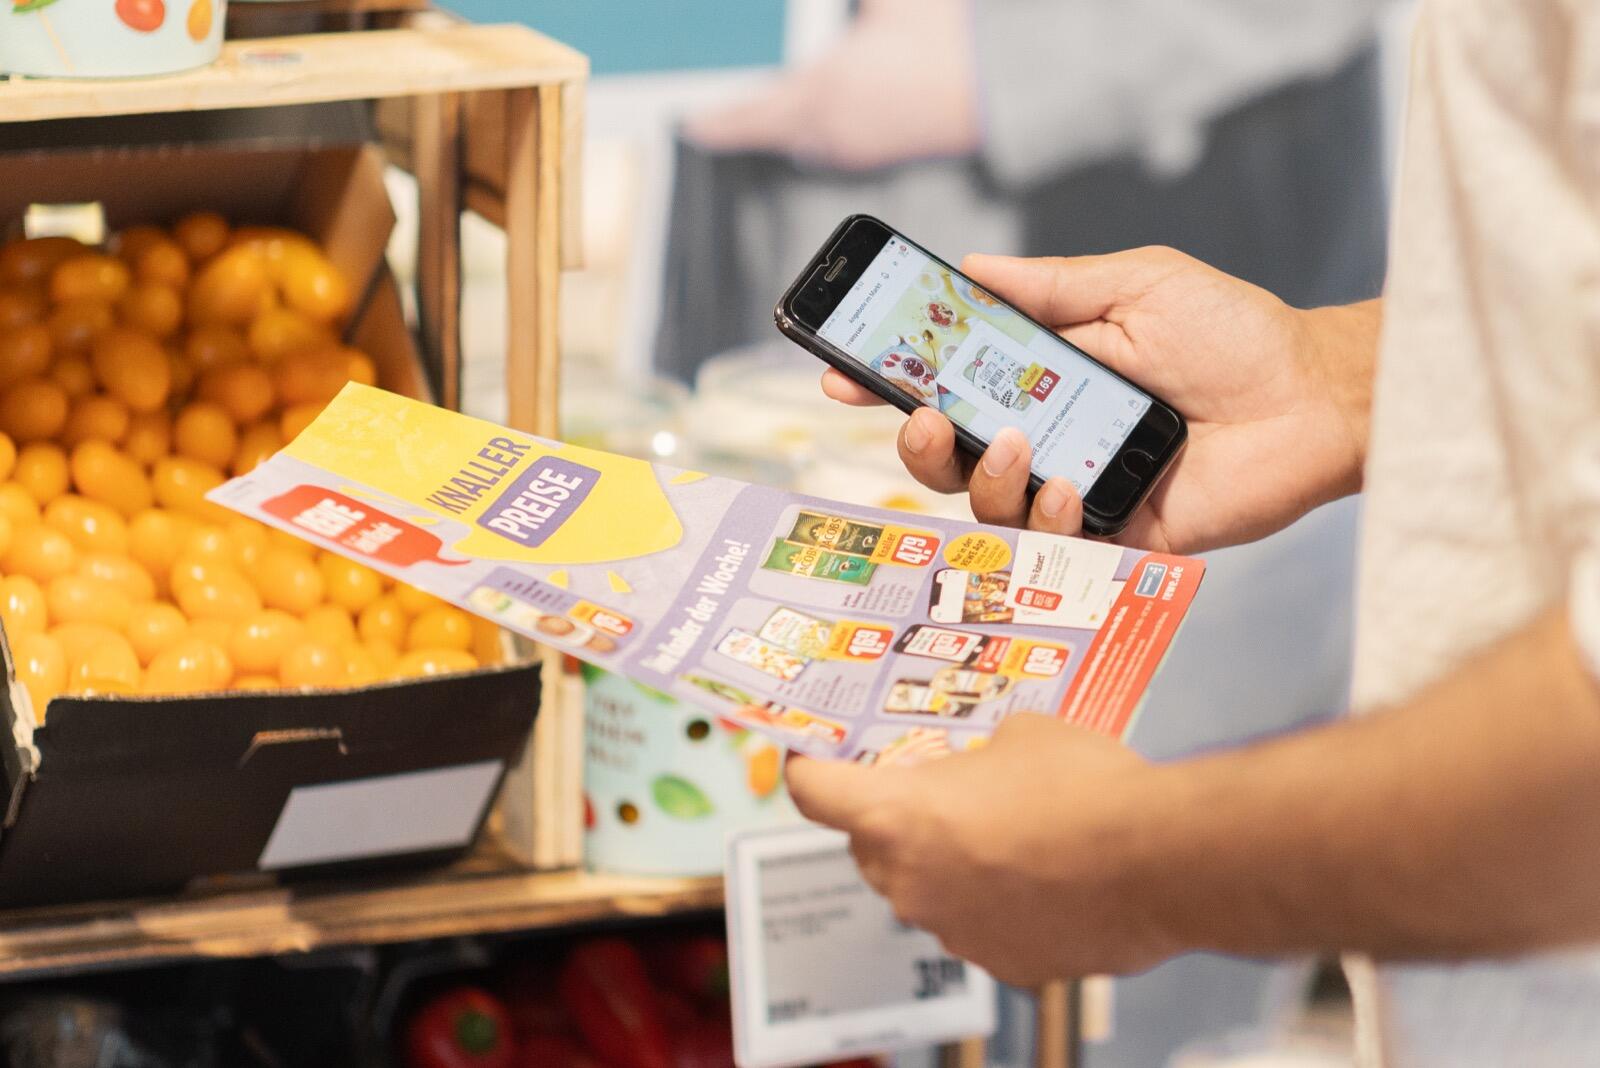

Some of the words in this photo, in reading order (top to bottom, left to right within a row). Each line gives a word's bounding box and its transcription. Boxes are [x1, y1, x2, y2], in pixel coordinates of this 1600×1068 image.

[1035, 375, 1054, 396] 1.69
[426, 437, 531, 514] KNALLER
[487, 467, 583, 539] PREISE
[820, 516, 845, 551] JACOBS
[696, 538, 752, 598] Woche!
